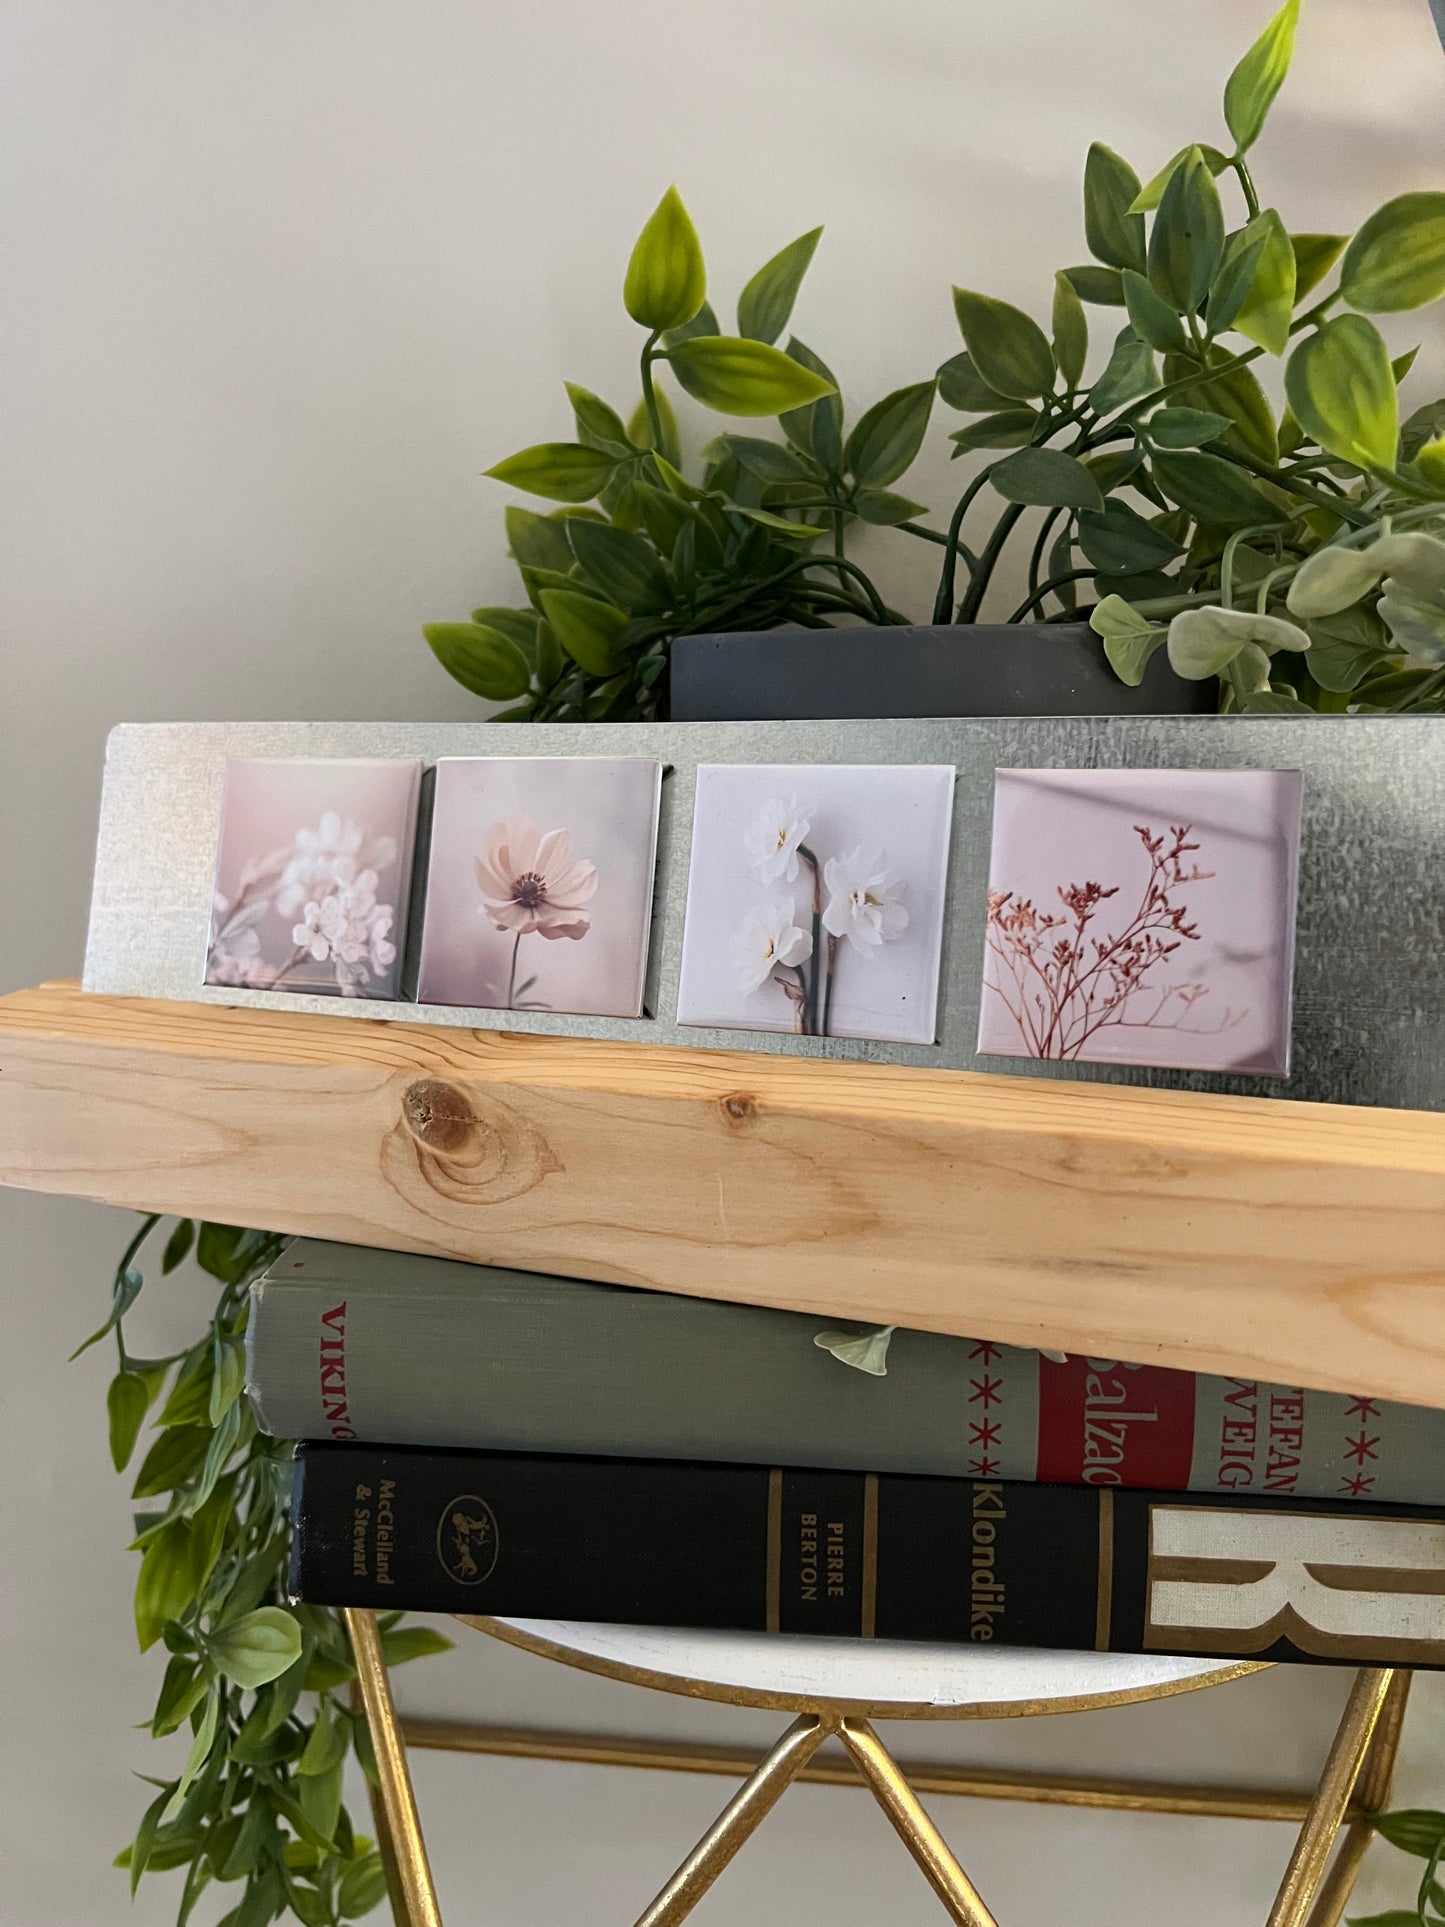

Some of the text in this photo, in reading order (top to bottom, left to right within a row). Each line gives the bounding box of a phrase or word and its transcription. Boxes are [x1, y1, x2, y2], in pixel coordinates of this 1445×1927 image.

[320, 1301, 359, 1439] VIKING
[1217, 1376, 1257, 1489] WEIG
[353, 1484, 372, 1576] & Stewart
[376, 1479, 396, 1584] McClelland
[801, 1513, 817, 1600] BERTON
[828, 1522, 844, 1597] PIERRE
[970, 1483, 1006, 1641] Klondike
